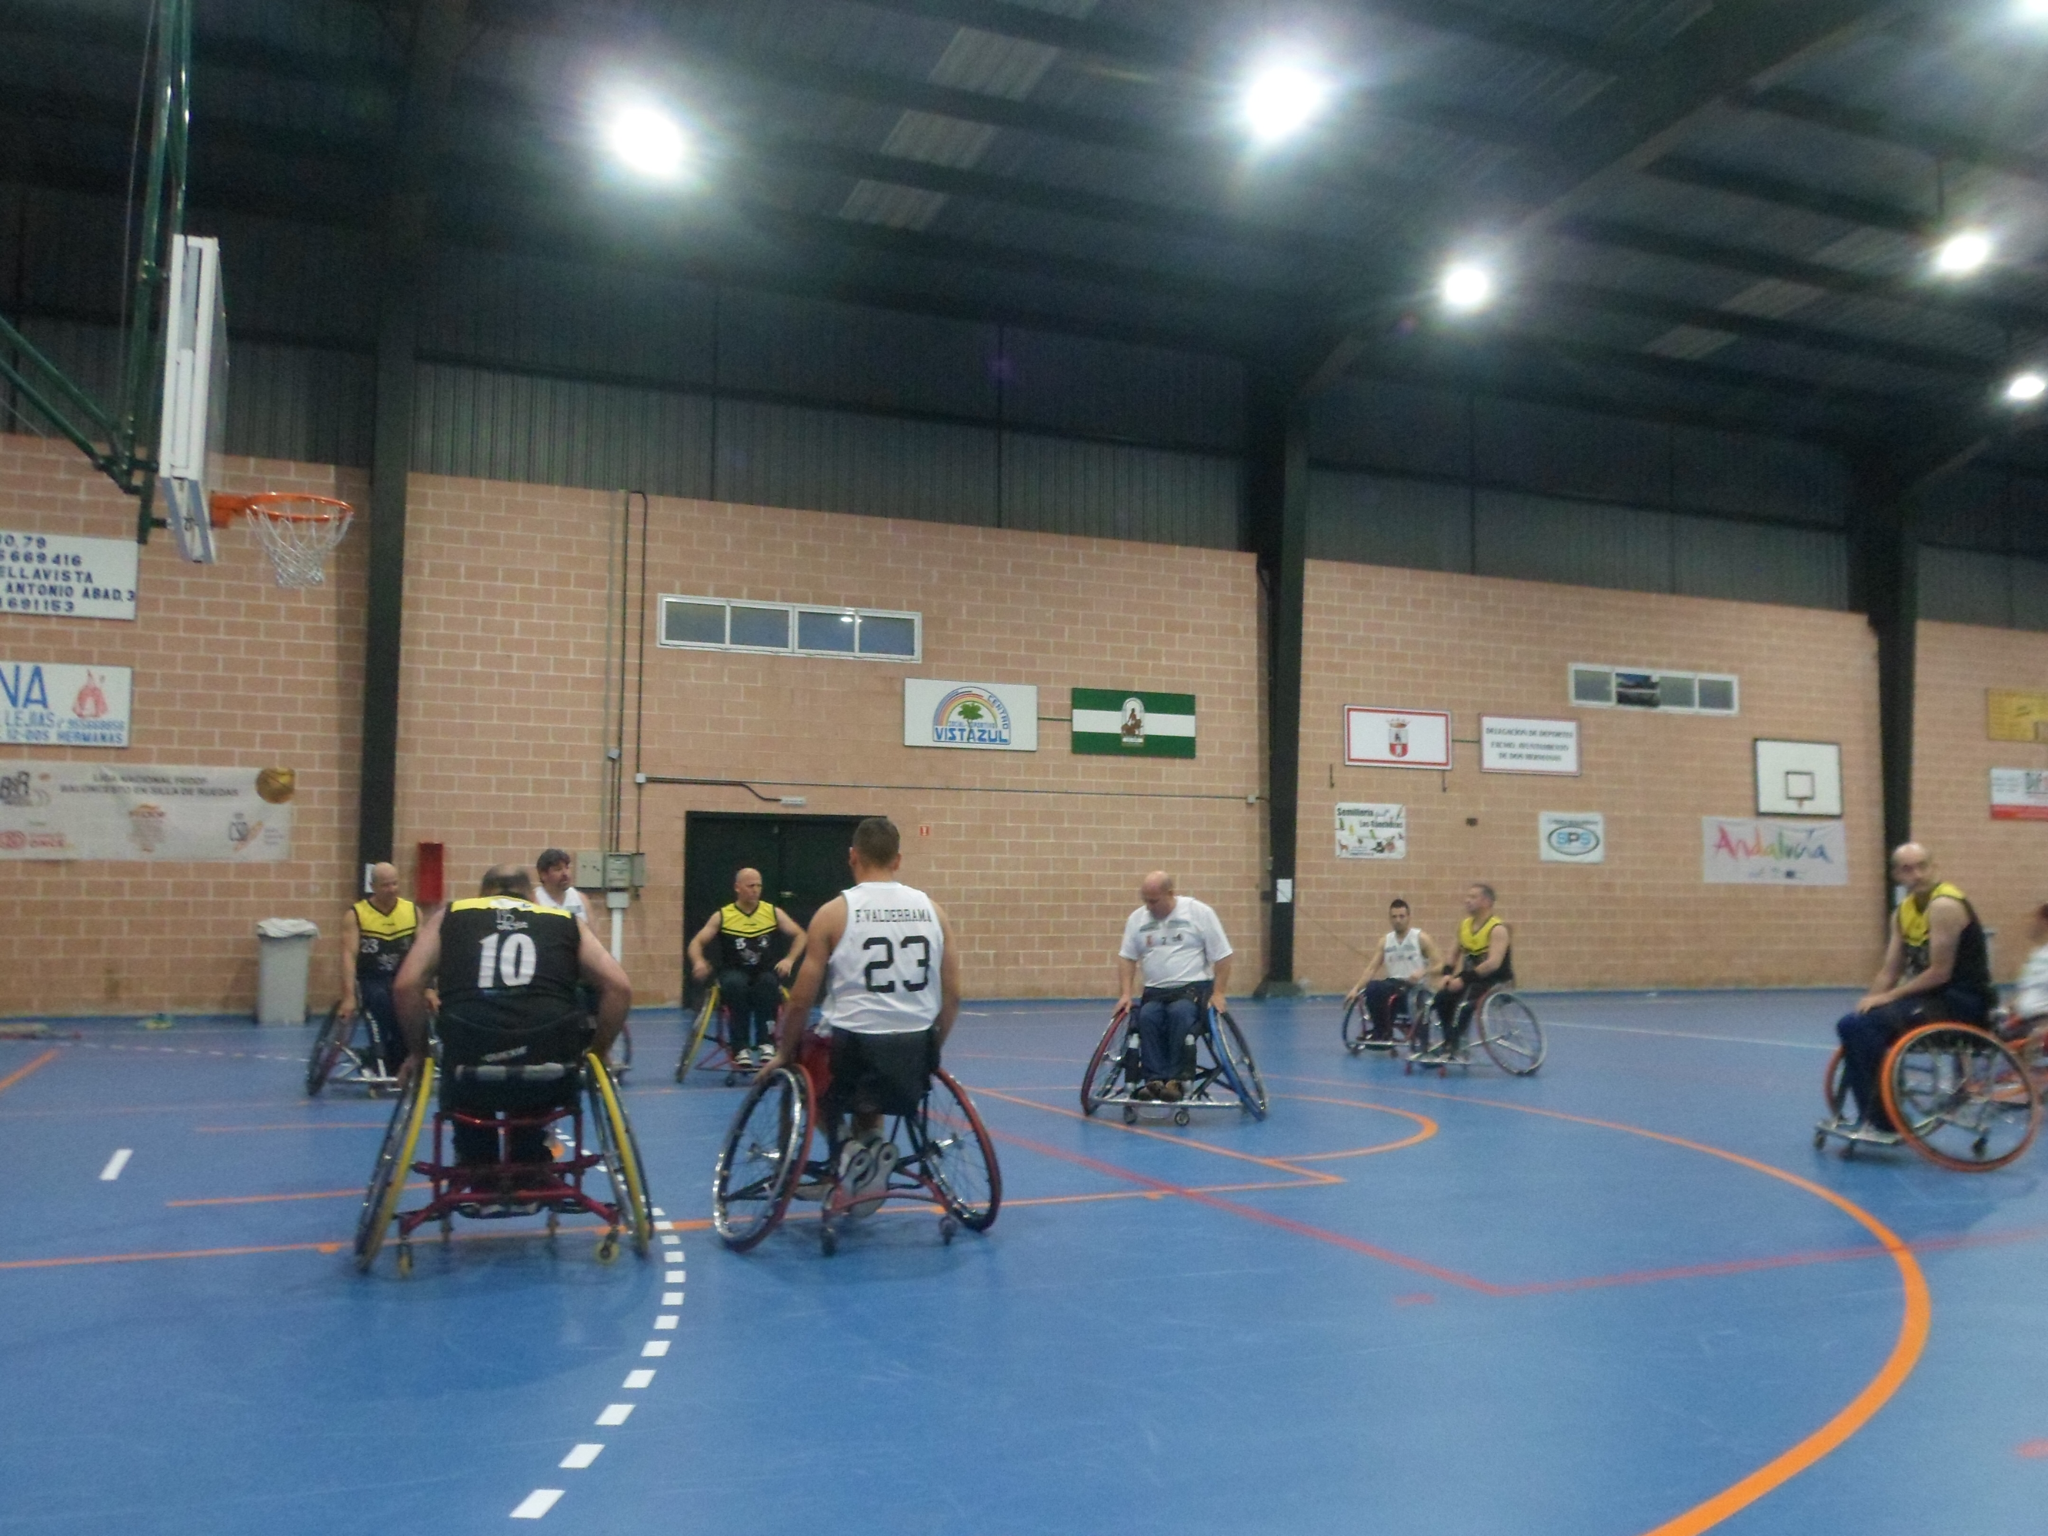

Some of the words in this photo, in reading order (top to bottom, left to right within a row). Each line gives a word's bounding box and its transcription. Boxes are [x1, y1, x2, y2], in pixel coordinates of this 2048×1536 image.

[6, 582, 73, 598] ANTONIO
[987, 694, 1009, 730] CENTRO
[935, 727, 1008, 743] VISTAZUL
[478, 932, 536, 988] 10
[863, 936, 930, 993] 23
